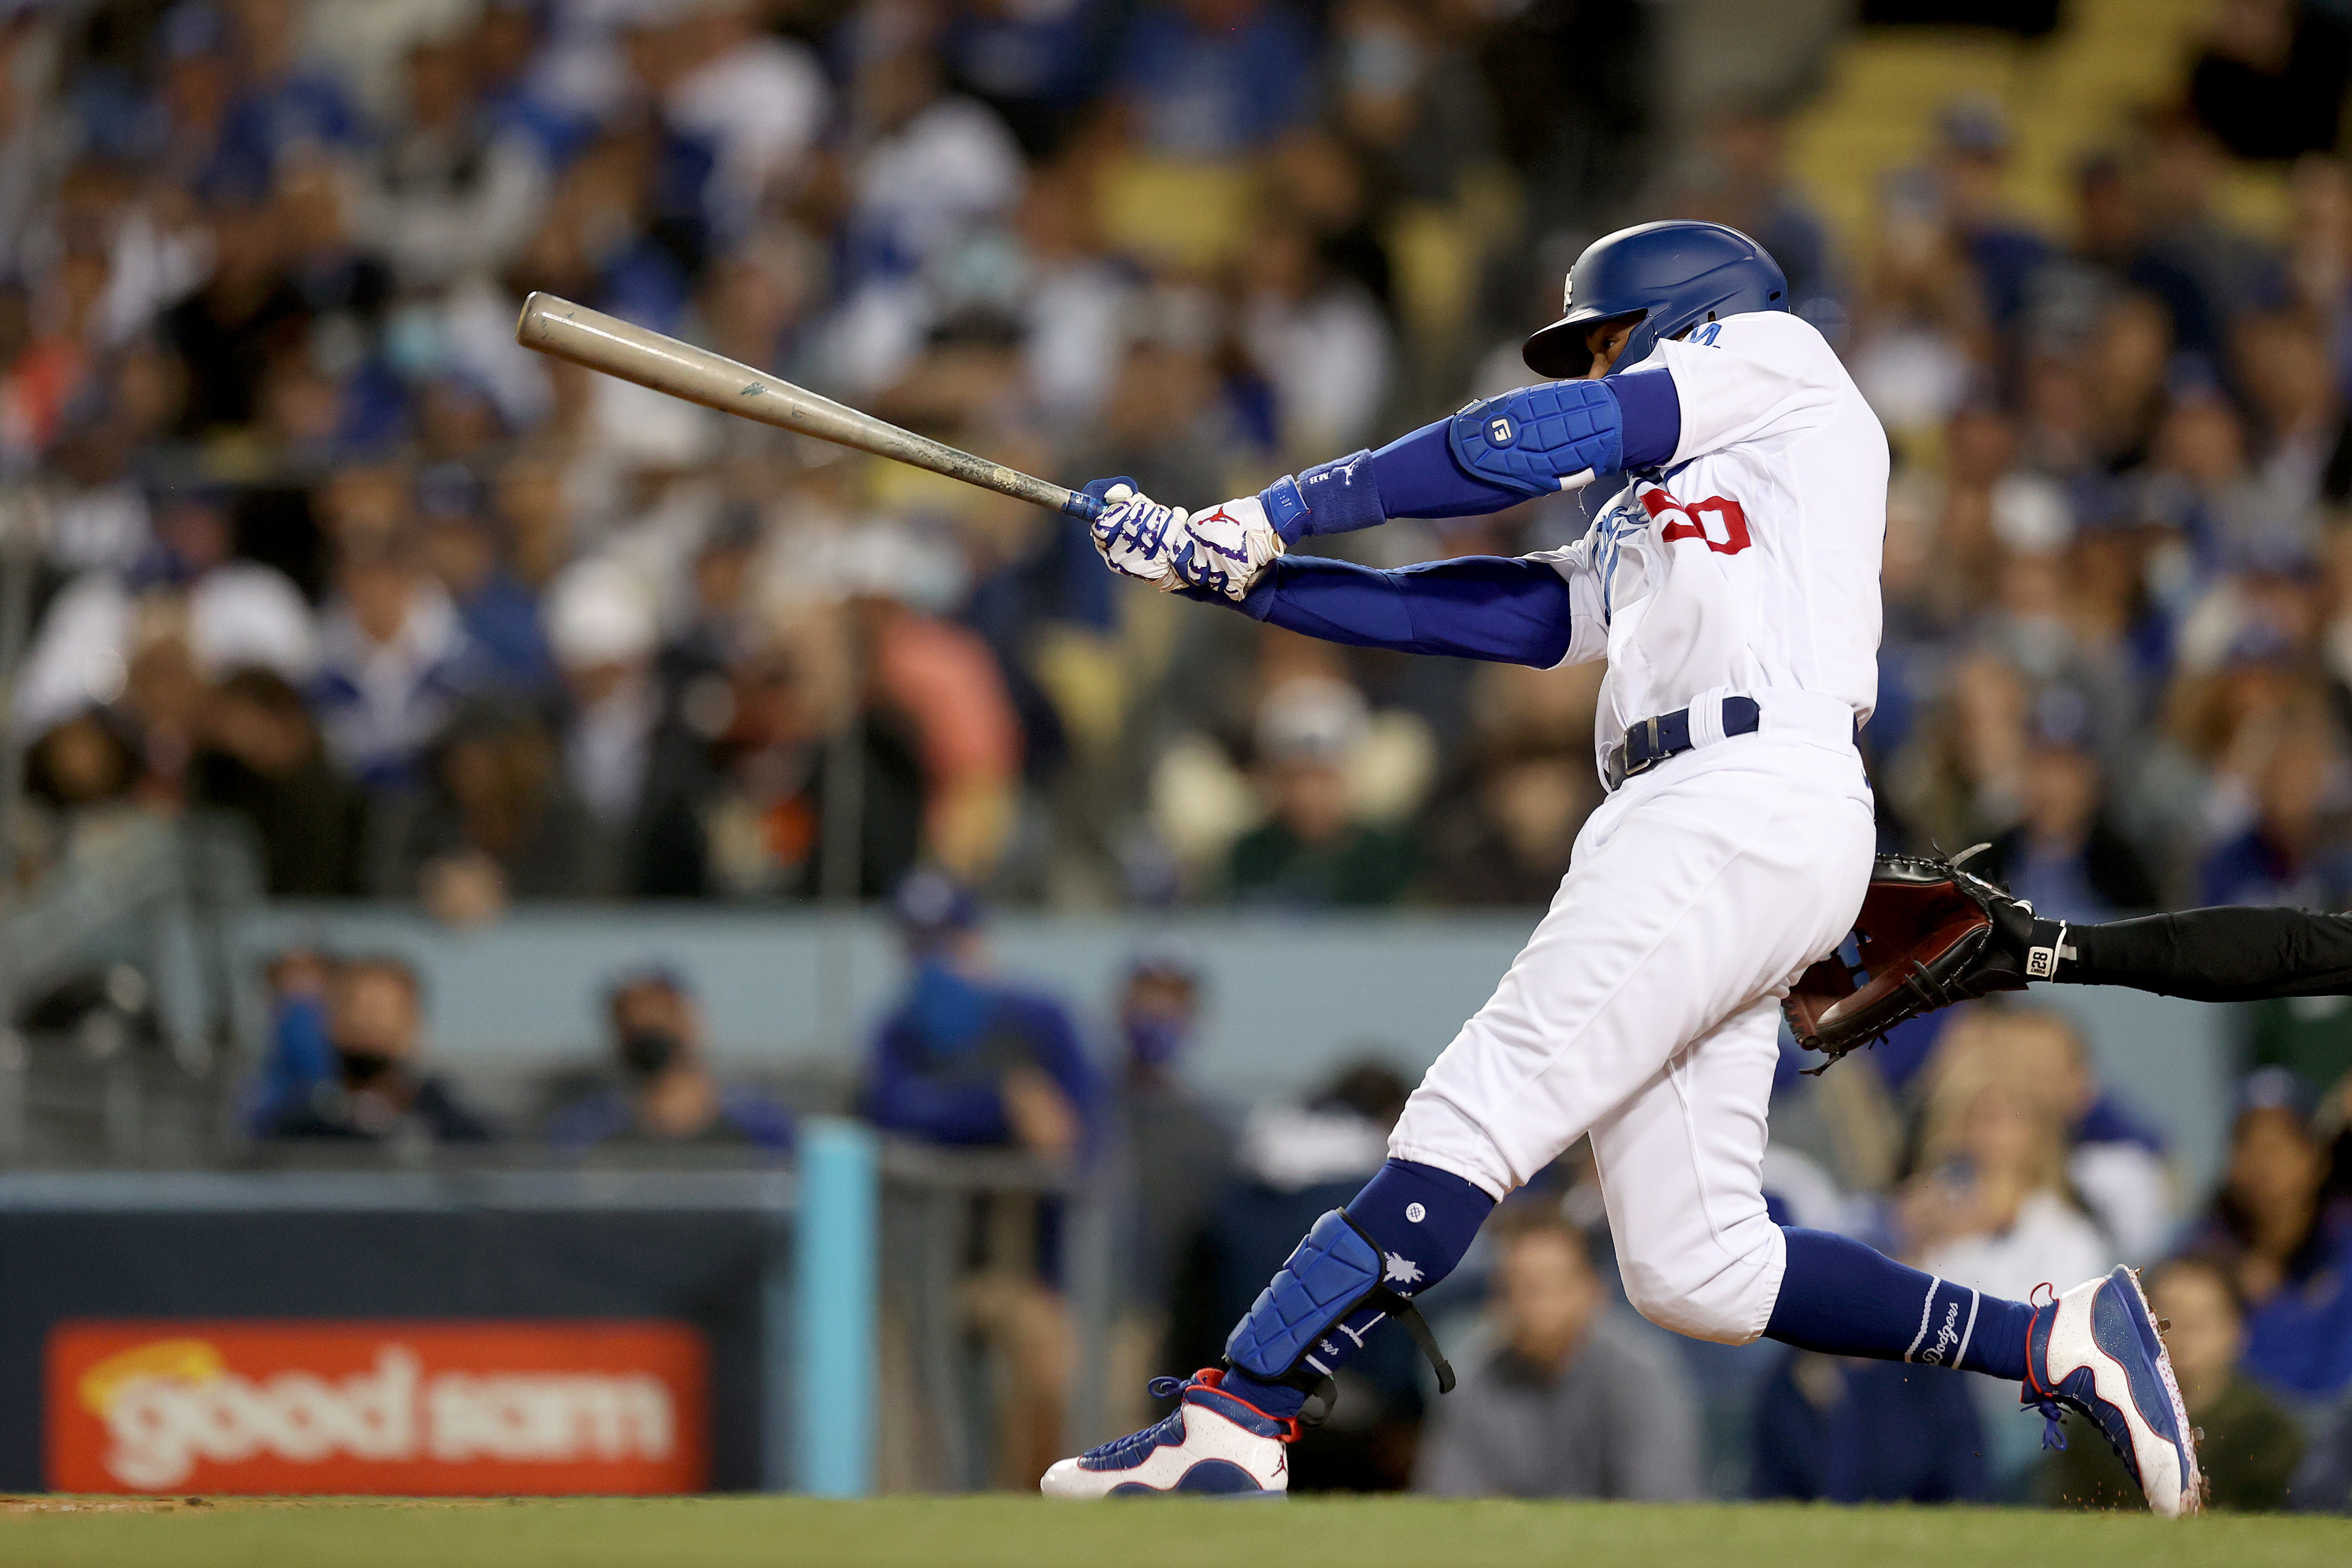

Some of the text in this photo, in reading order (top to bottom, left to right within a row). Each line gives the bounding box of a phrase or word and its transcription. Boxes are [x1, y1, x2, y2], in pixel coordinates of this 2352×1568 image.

[1309, 472, 1329, 484] MB
[2031, 952, 2048, 969] 28
[1922, 1302, 1959, 1365] Dodgers
[106, 1345, 673, 1485] good sam
